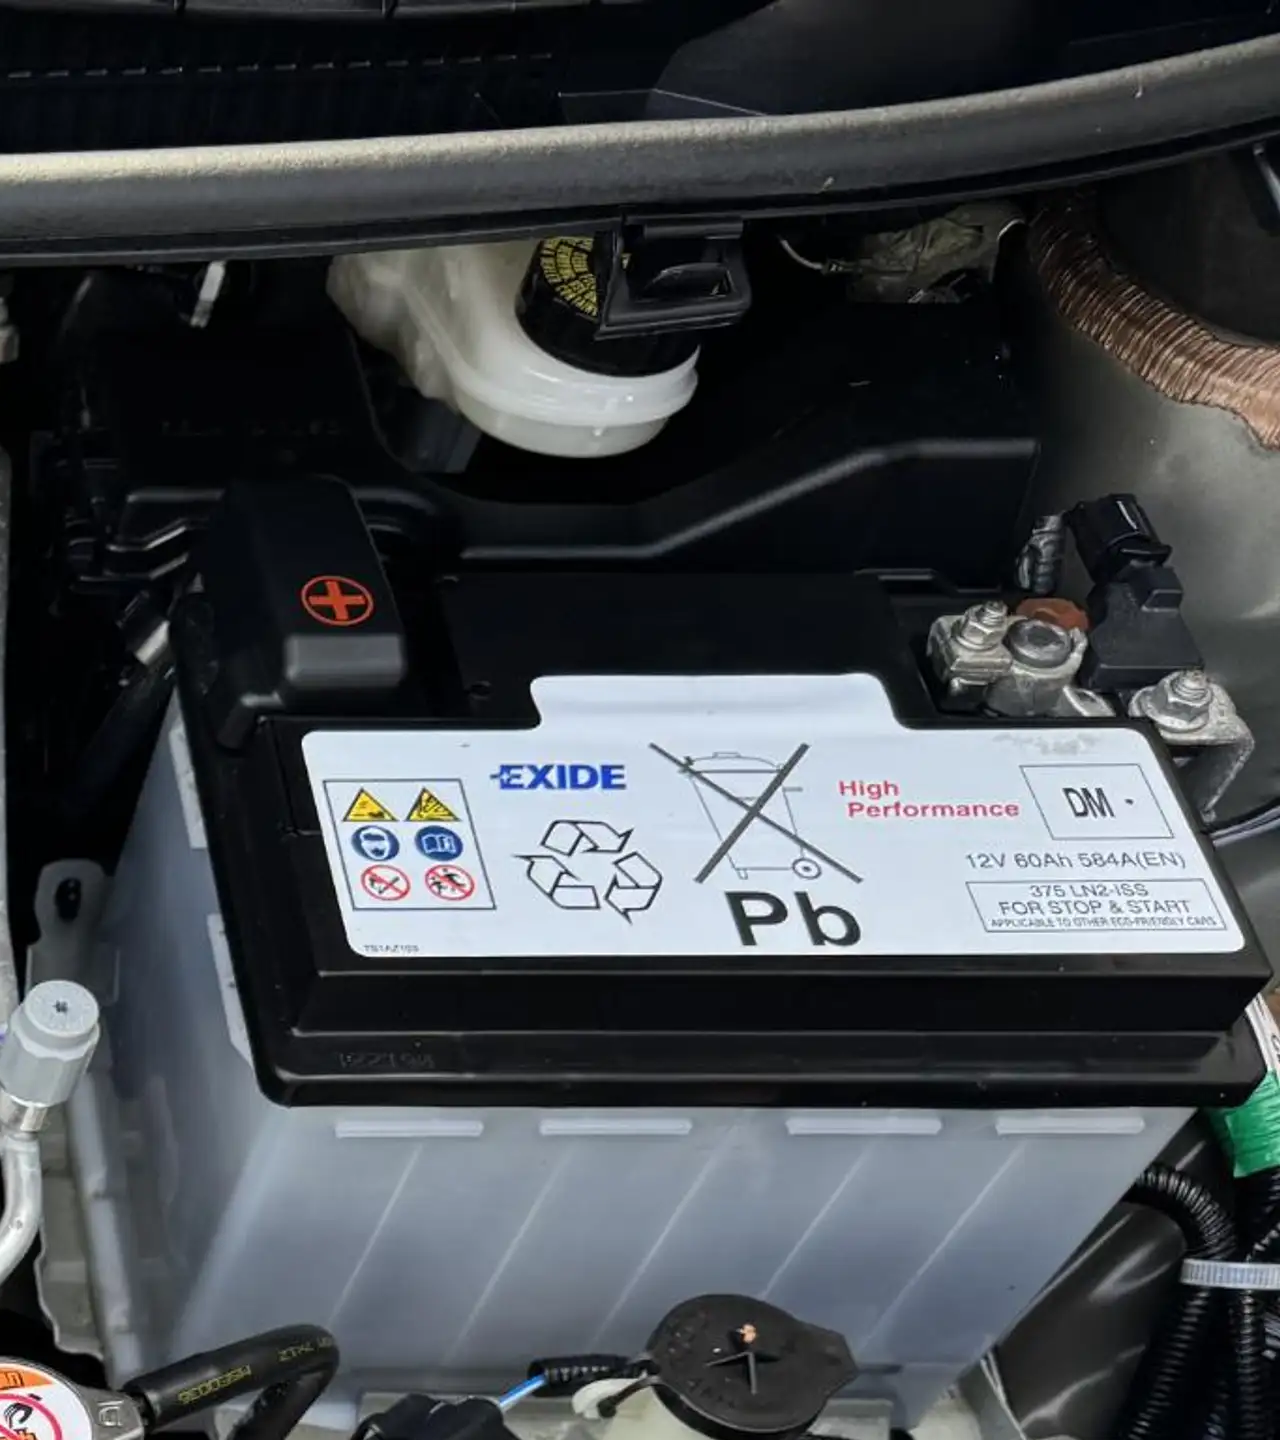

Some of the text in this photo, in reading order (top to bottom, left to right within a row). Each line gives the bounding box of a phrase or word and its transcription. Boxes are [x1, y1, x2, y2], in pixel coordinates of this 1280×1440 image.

[489, 764, 627, 791] EXIDE
[839, 780, 900, 800] High
[848, 801, 1020, 818] Performance
[1063, 787, 1116, 818] DM
[965, 851, 1187, 869] 12V 60Ah 584A(EN)
[1030, 884, 1150, 898] 375 LN2-ISS
[998, 899, 1191, 916] FOR STOP & START
[722, 890, 863, 948] Pb
[990, 918, 1055, 928] APPLICABLE
[1074, 917, 1109, 928] OTHER
